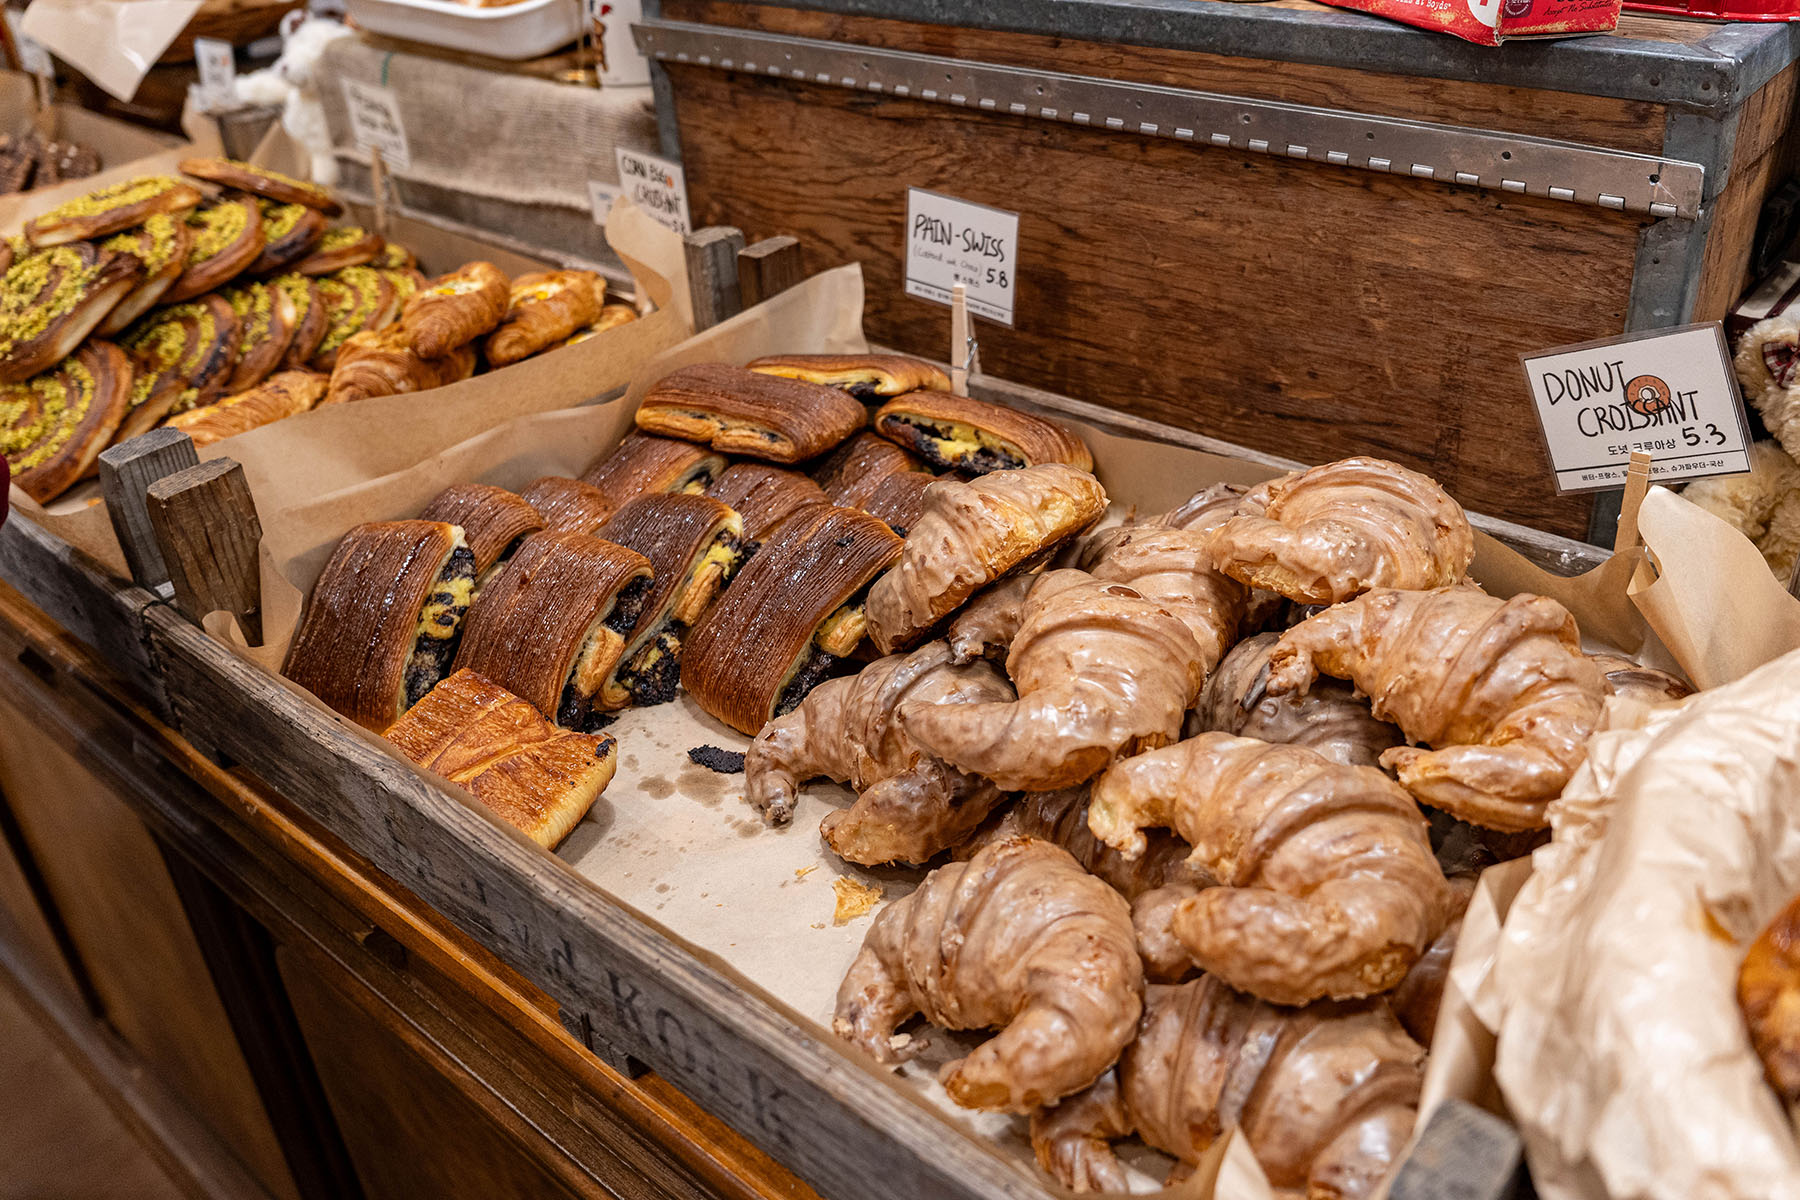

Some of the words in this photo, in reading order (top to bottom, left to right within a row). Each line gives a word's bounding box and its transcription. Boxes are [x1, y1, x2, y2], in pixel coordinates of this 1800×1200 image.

[985, 267, 1009, 289] 5.8
[1542, 360, 1627, 406] DONUT
[1576, 390, 1700, 438] CROISSANT
[1681, 423, 1727, 447] 5.3
